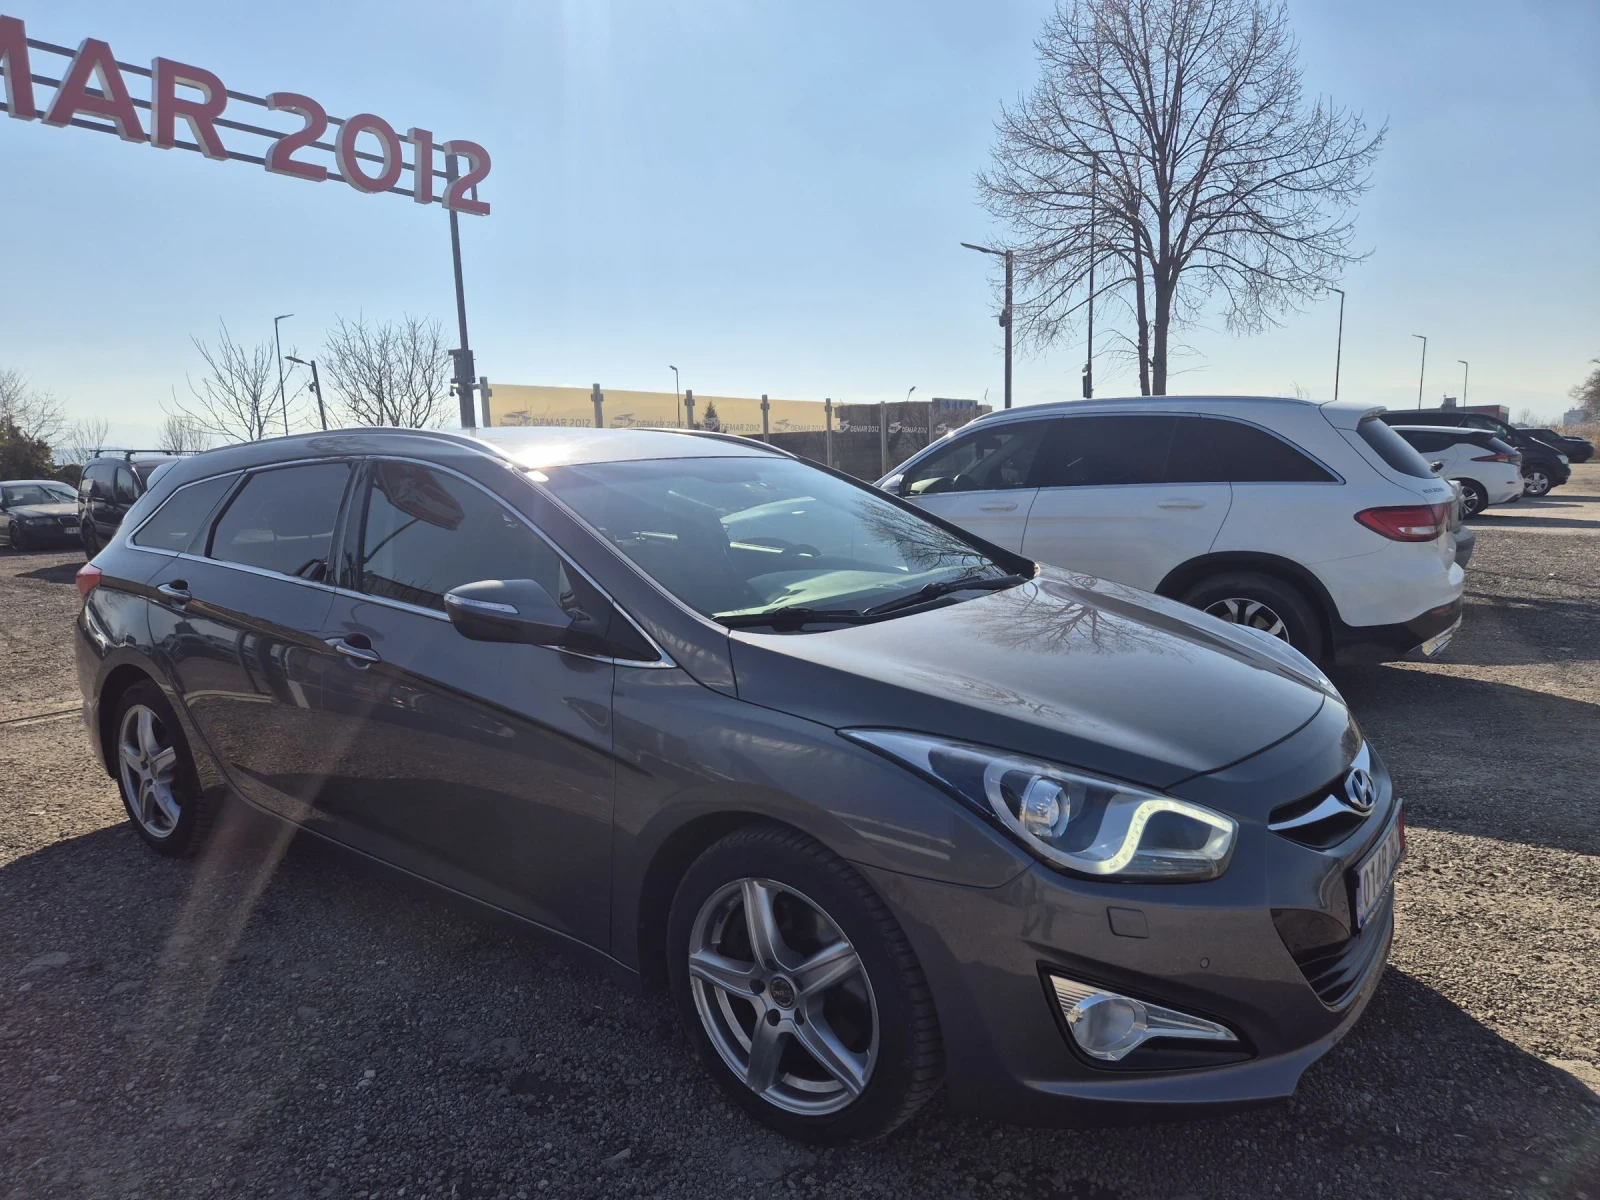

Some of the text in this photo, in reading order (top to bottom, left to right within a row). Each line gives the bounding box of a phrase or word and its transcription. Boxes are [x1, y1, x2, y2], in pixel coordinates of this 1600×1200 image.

[265, 92, 491, 215] 2012
[533, 418, 591, 428] DEMAR 2012
[721, 423, 761, 432] DEMAR 2012
[790, 424, 811, 432] DEMAR
[850, 425, 880, 433] DEMAR 2012
